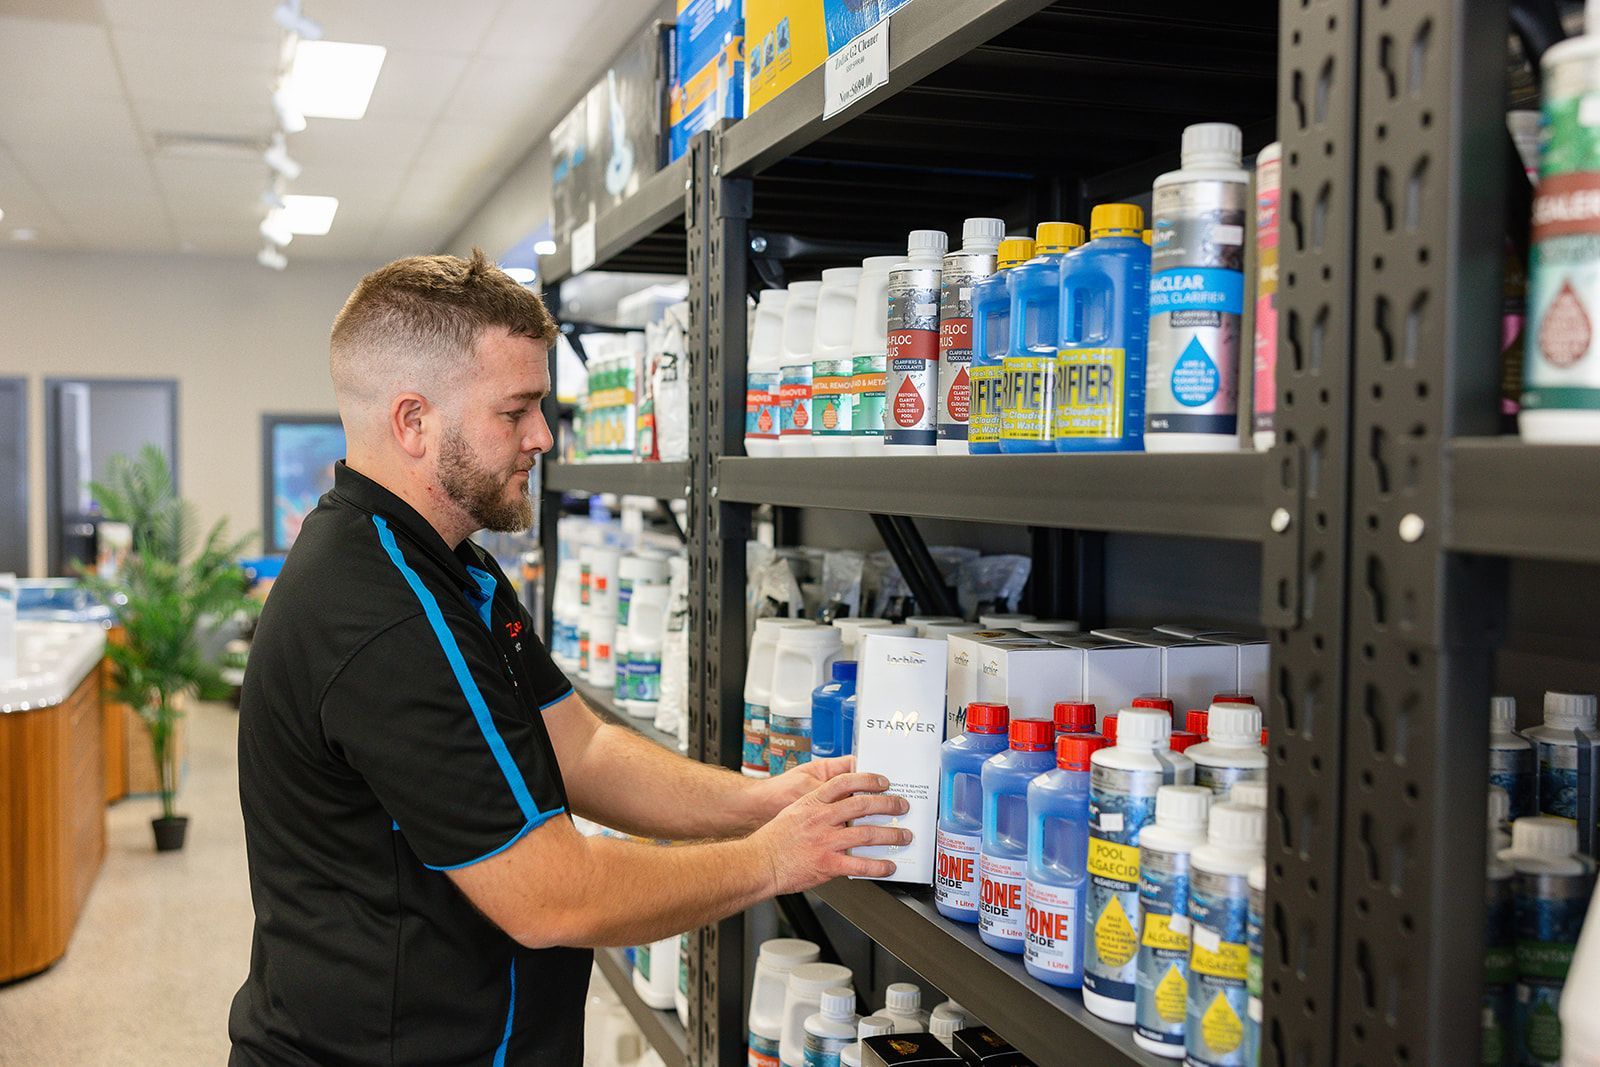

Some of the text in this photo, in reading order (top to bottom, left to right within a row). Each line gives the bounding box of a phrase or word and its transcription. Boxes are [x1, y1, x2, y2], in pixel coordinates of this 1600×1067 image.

[857, 33, 879, 53] Cleaner
[866, 719, 936, 734] STARVER
[1096, 844, 1126, 862] POOL
[960, 900, 975, 908] Litre
[1006, 928, 1023, 937] Litre
[1052, 961, 1070, 970] Litre
